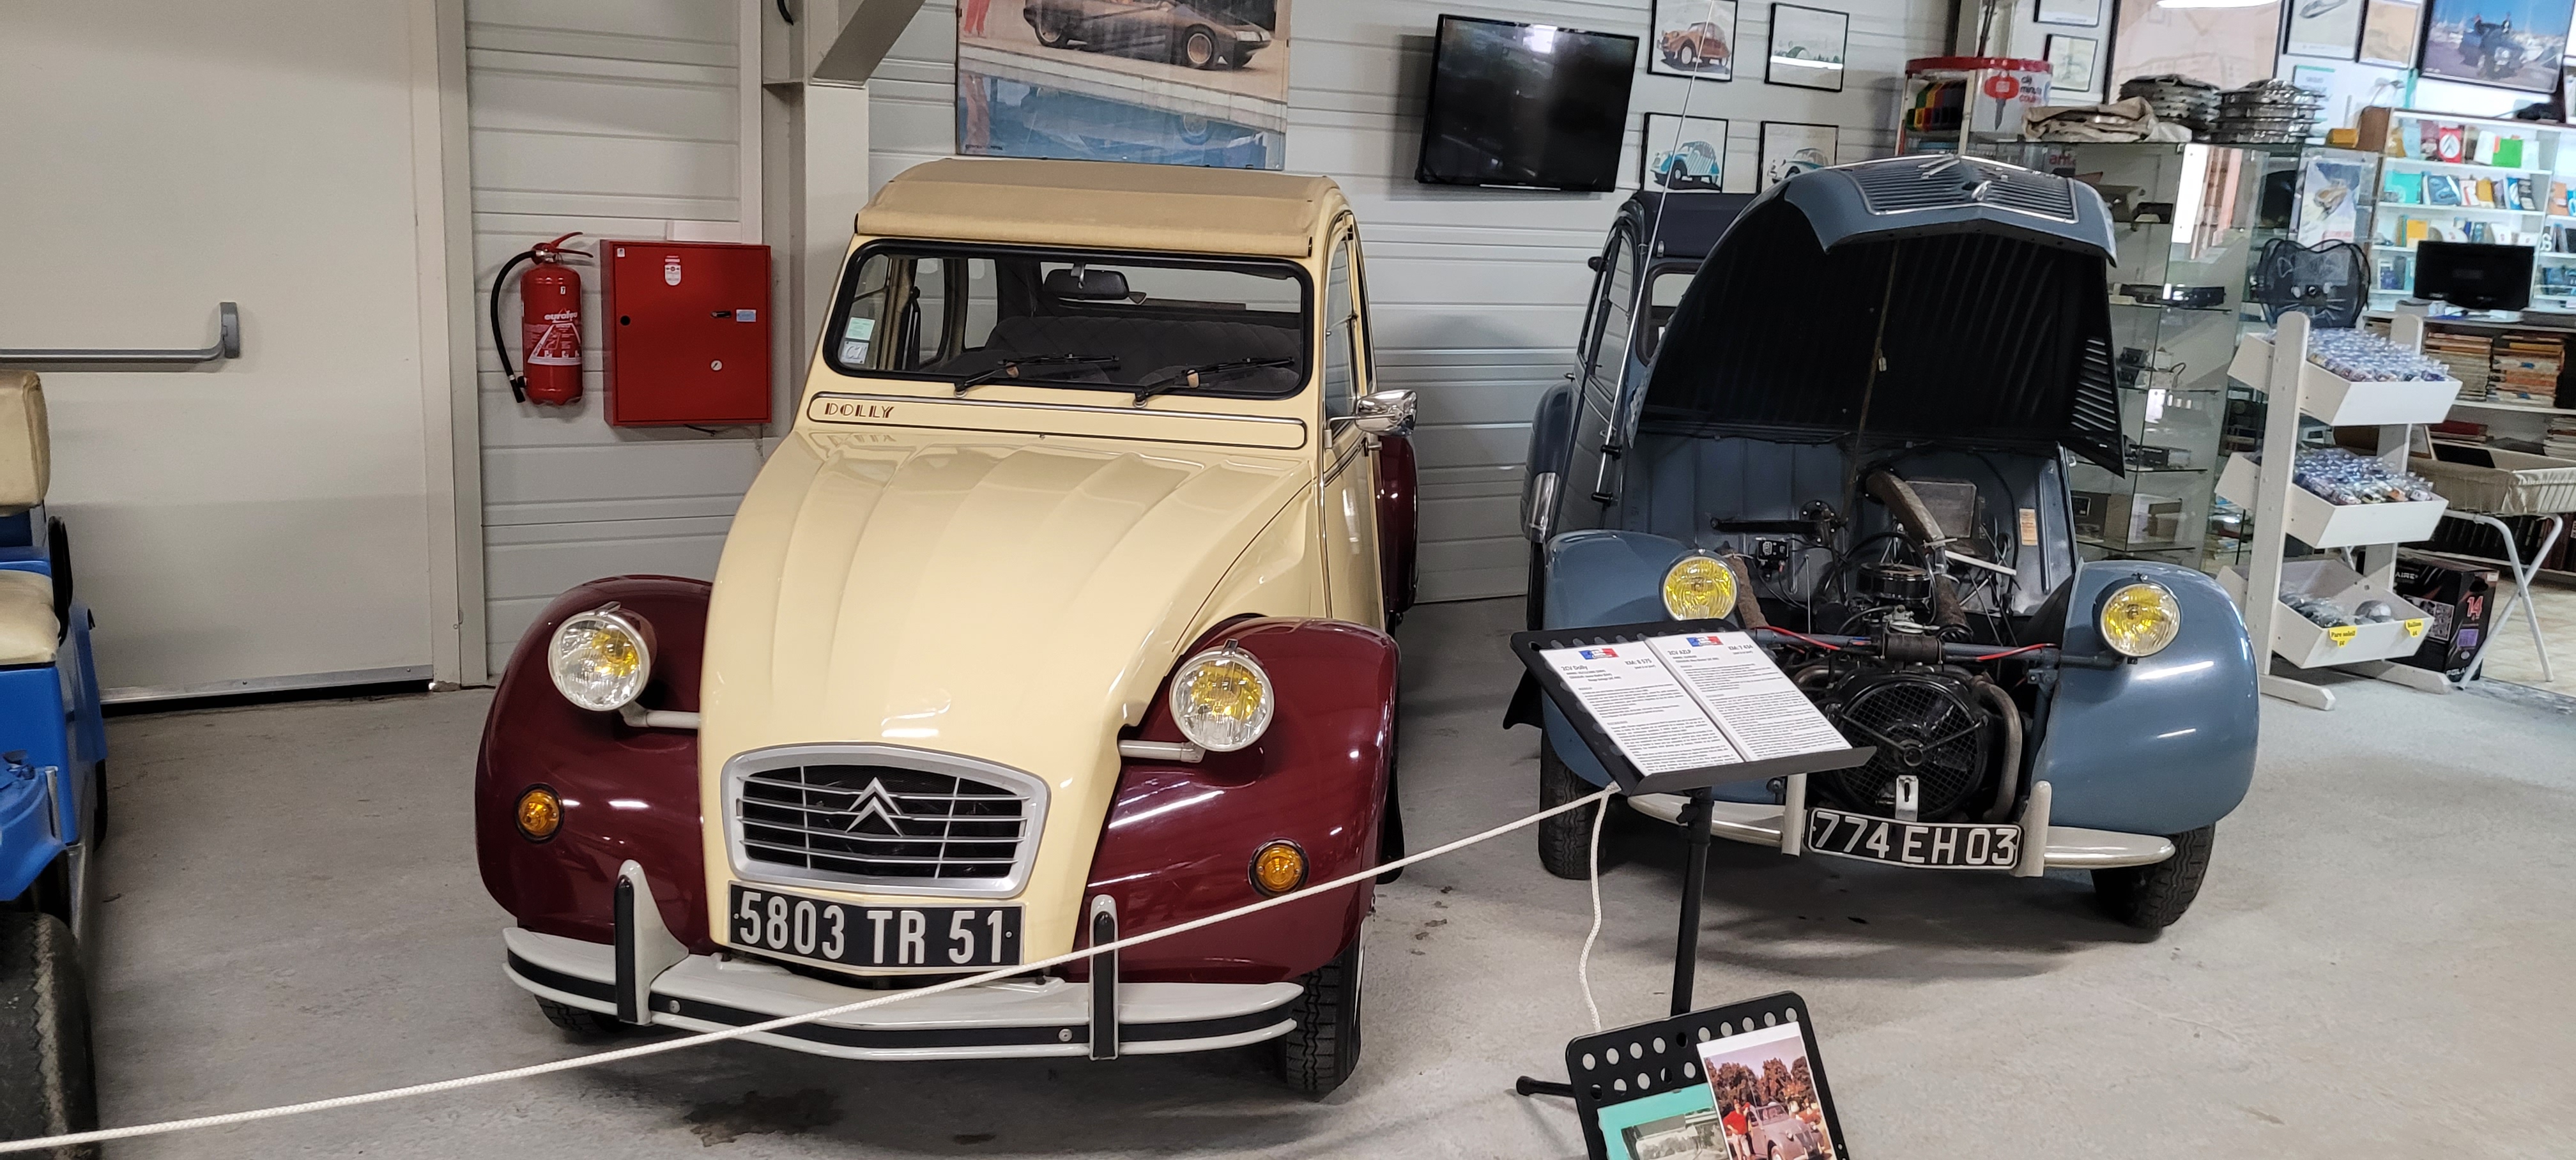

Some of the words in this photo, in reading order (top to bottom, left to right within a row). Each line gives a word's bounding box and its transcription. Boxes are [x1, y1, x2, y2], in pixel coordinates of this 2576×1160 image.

[825, 402, 895, 418] DOLLY
[2467, 595, 2484, 618] 14
[1816, 811, 1890, 859] 774
[1901, 825, 1958, 864] EH
[1966, 828, 2018, 865] 03
[739, 890, 845, 959] 5803
[867, 910, 926, 965] TR
[948, 910, 1003, 964] 51
